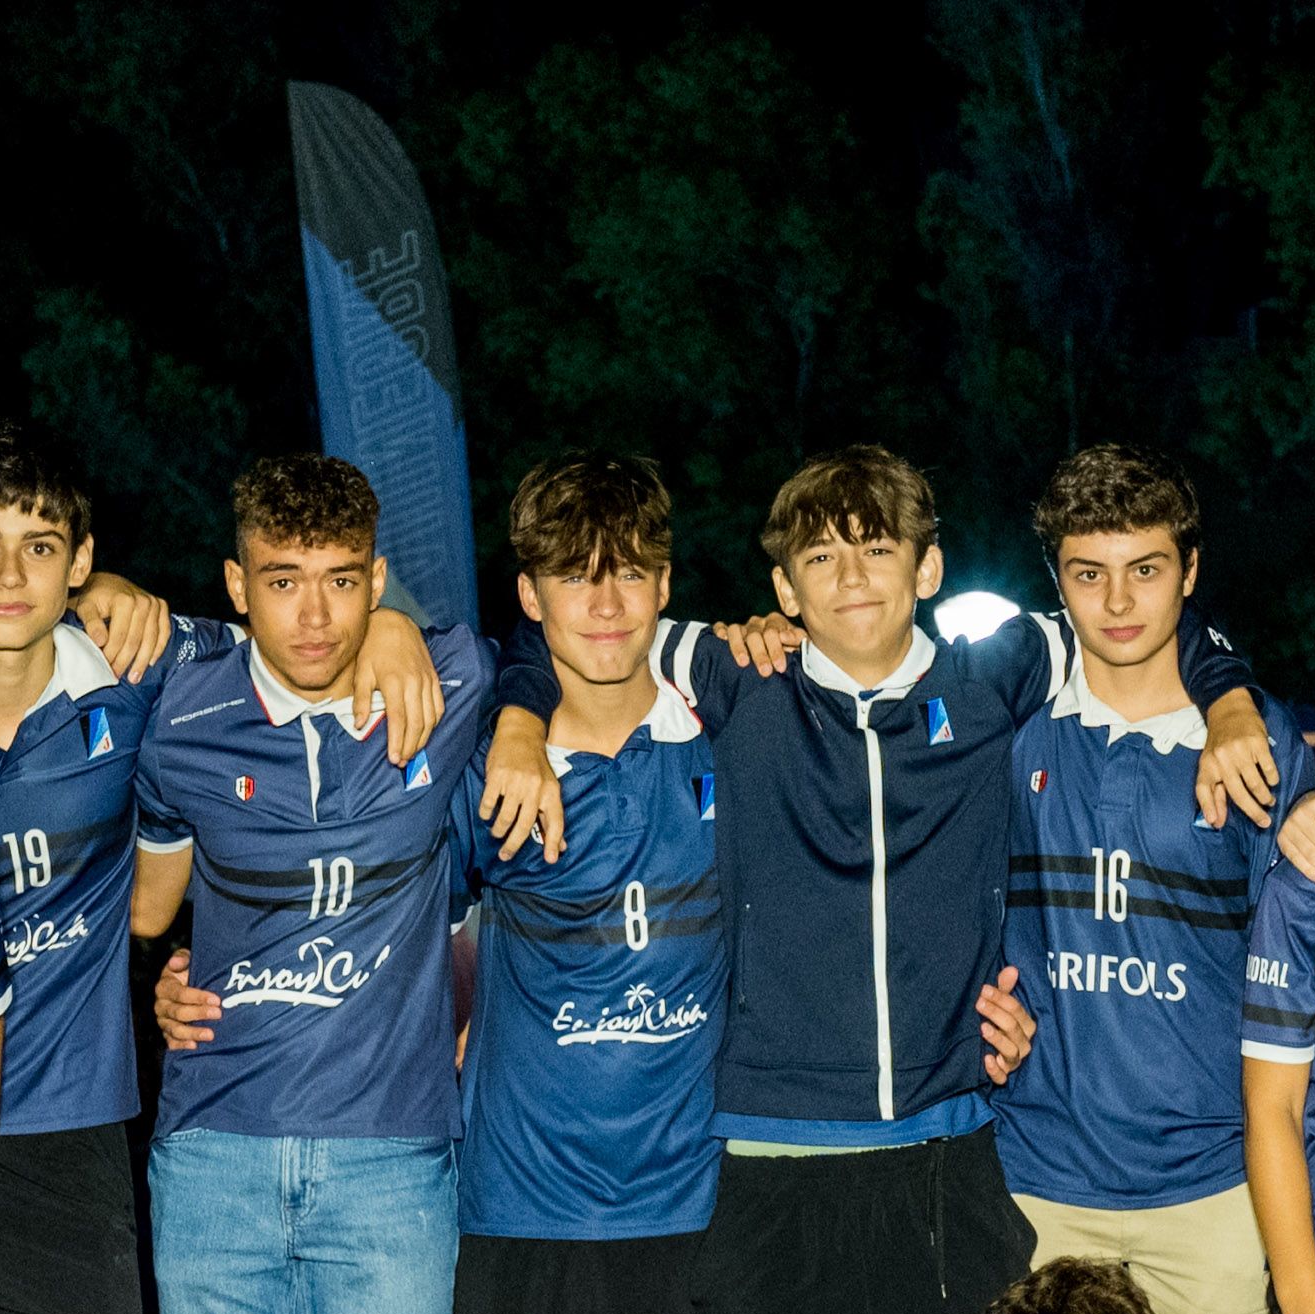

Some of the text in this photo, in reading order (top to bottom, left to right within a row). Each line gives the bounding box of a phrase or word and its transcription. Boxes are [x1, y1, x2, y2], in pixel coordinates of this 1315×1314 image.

[171, 698, 246, 726] PORSCHE
[2, 828, 52, 895] 19
[308, 856, 354, 920] 10
[1092, 847, 1131, 923] 16
[624, 880, 649, 952] 8
